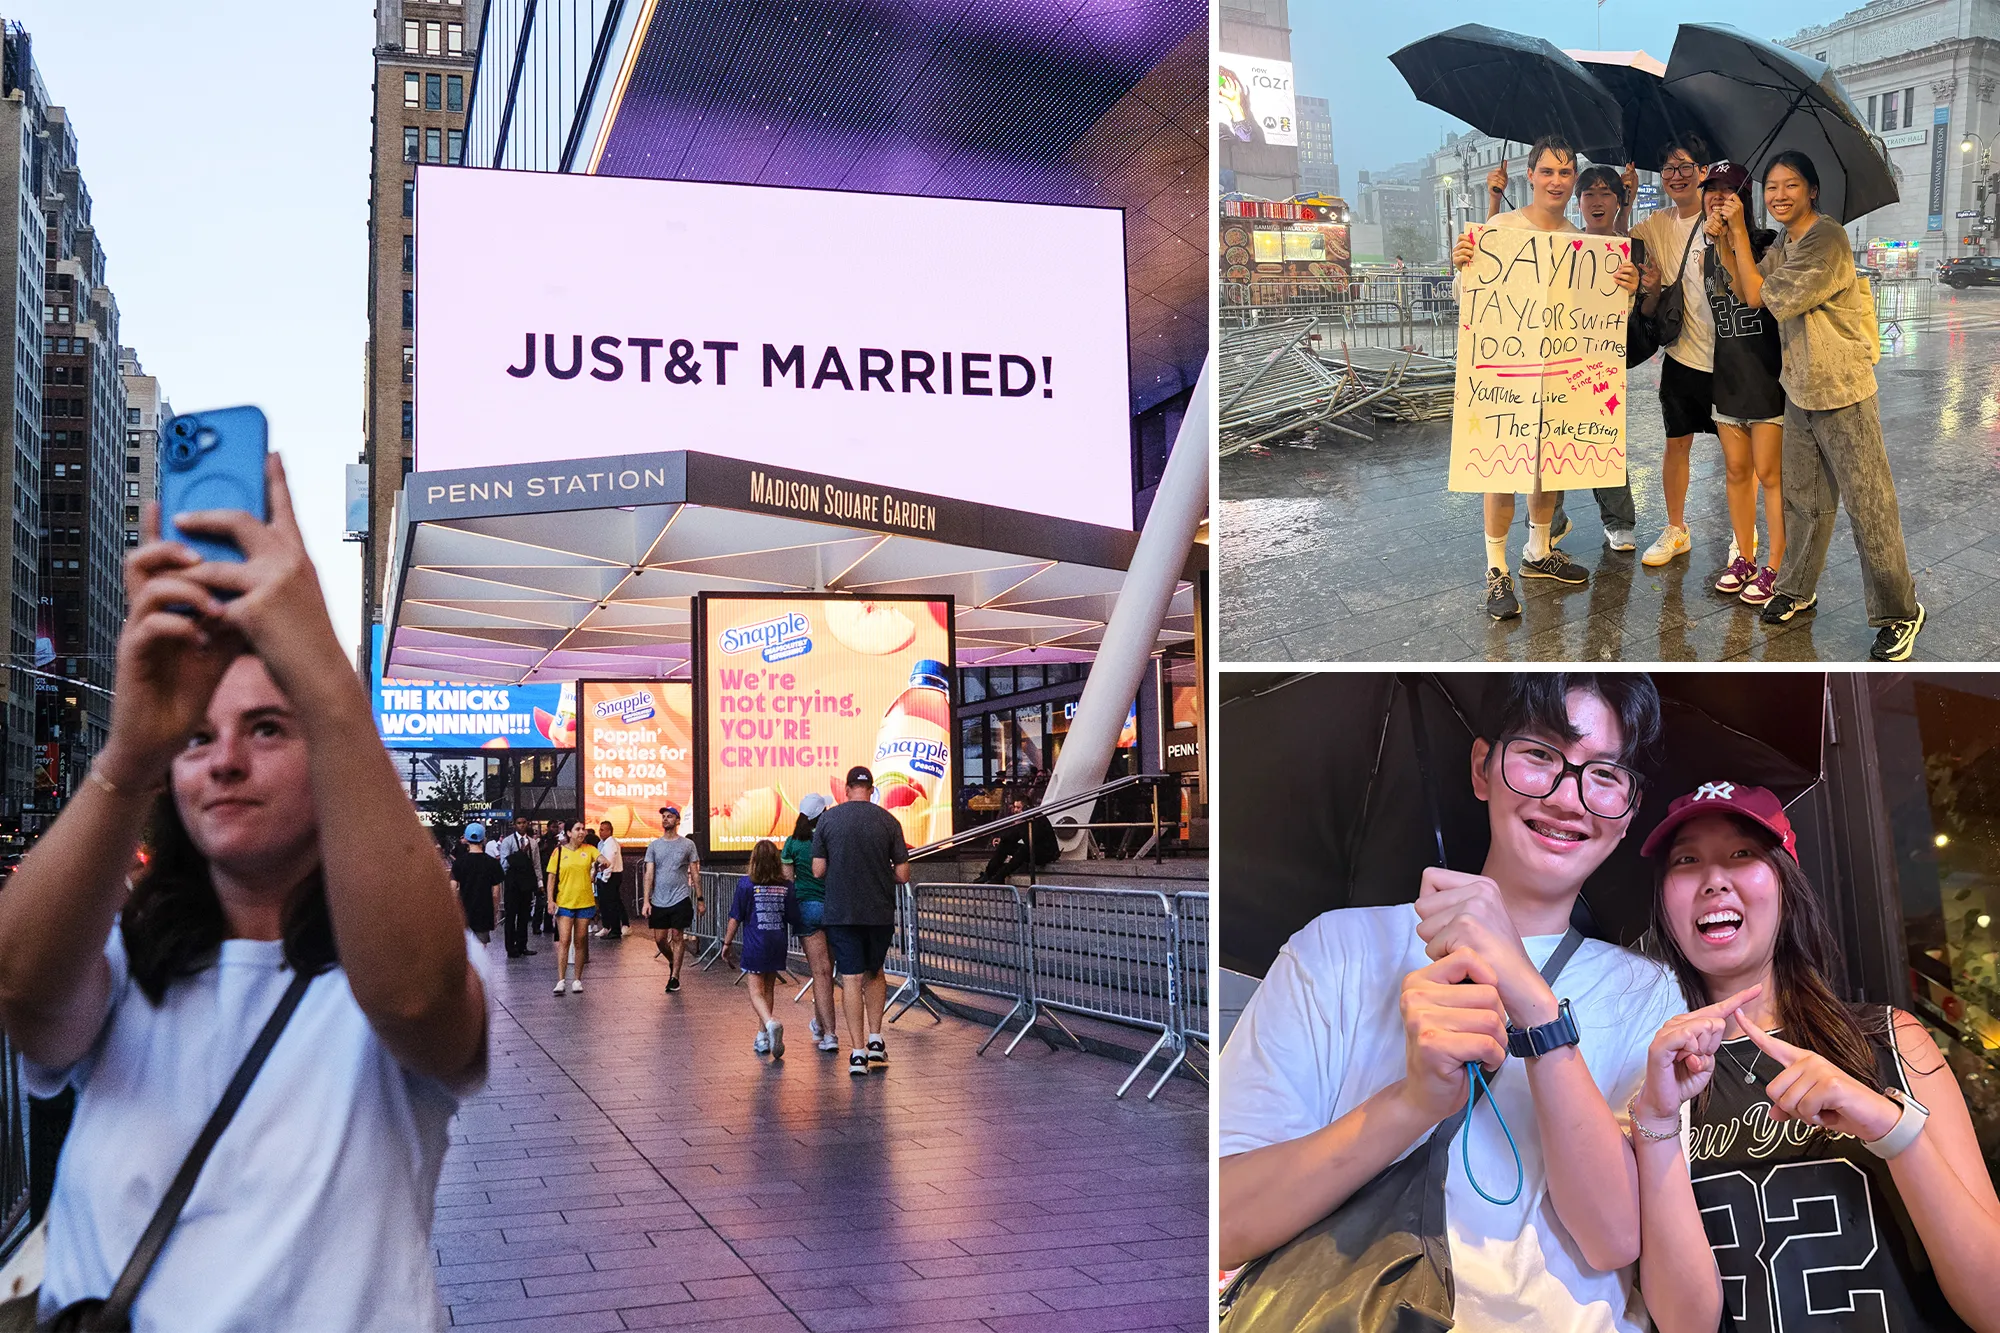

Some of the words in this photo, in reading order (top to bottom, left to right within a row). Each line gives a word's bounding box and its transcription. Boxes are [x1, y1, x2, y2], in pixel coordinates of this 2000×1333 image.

[1253, 75, 1289, 91] razr
[1887, 137, 1906, 146] TRAIN
[1907, 134, 1924, 143] HALL
[1936, 127, 1944, 157] STATION
[1933, 159, 1942, 212] PENNSYLVANIA
[1709, 292, 1763, 339] 32
[506, 331, 740, 387] JUST&T
[761, 342, 1053, 399] MARRIED!
[1566, 369, 1585, 384] been
[1571, 376, 1592, 392] since
[1532, 391, 1569, 405] Live
[1592, 381, 1610, 396] AM
[1485, 412, 1531, 440] The
[427, 480, 513, 505] PENN
[526, 468, 666, 498] STATION
[723, 612, 806, 652] Snapple
[719, 668, 796, 690] We're
[381, 689, 423, 711] THE
[426, 689, 510, 711] KNICKS
[596, 691, 651, 716] Snapple
[720, 692, 766, 713] not
[772, 688, 862, 718] crying,
[380, 713, 531, 735] WONNNNN!!!
[720, 718, 811, 741] YOU'RE
[593, 726, 663, 746] Poppin'
[593, 745, 657, 761] bottles
[659, 745, 688, 761] for
[720, 745, 839, 768] CRYING!!!
[876, 740, 949, 762] Snapple
[1168, 743, 1195, 758] PENN
[593, 763, 624, 779] the
[627, 763, 667, 779] 2026
[914, 761, 936, 772] Peach
[593, 781, 669, 799] Champs!
[469, 802, 492, 810] STATION
[1168, 954, 1176, 1003] NYPD
